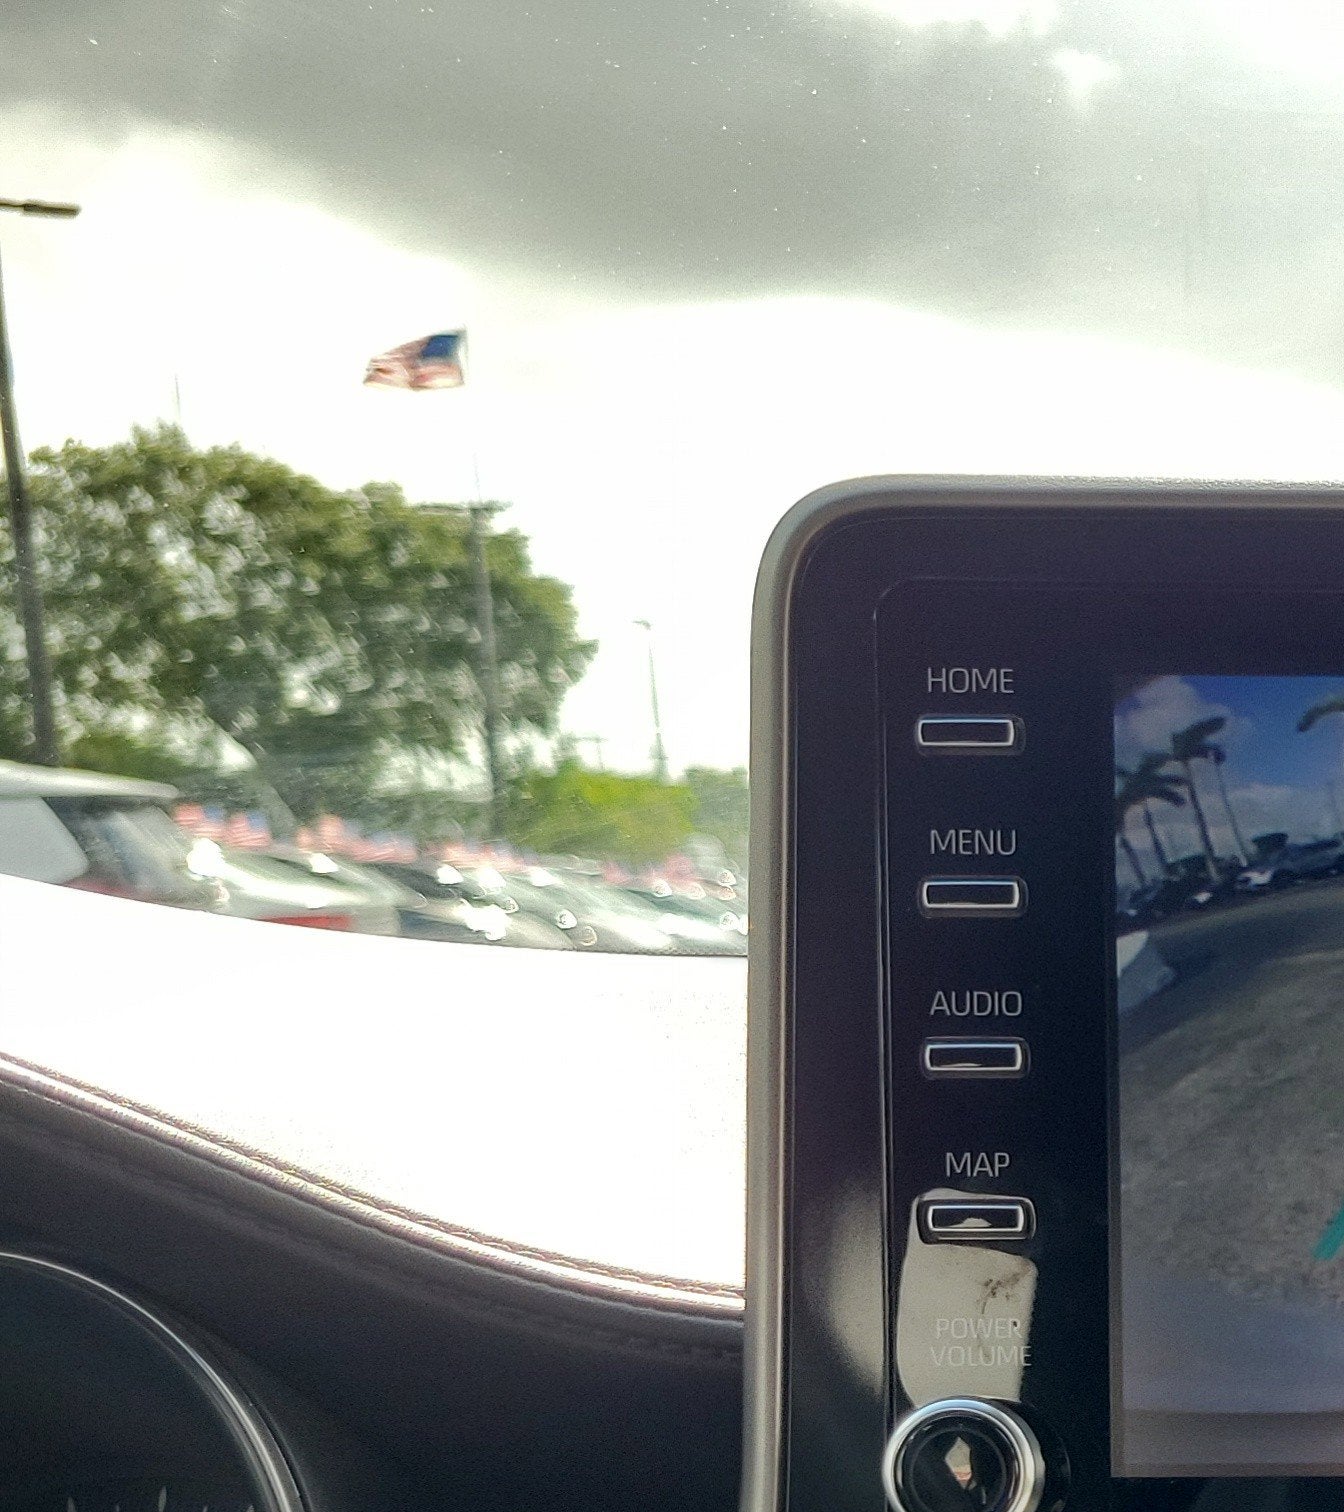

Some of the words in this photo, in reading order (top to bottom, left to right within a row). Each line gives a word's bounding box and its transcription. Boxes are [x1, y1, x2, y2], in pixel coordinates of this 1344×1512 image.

[926, 667, 1015, 694] HOME
[929, 829, 1017, 855] MENU
[929, 990, 1023, 1017] AUDIO
[945, 1151, 1011, 1178] MAP
[935, 1317, 1023, 1340] POWER
[930, 1345, 1033, 1368] VOLUME
